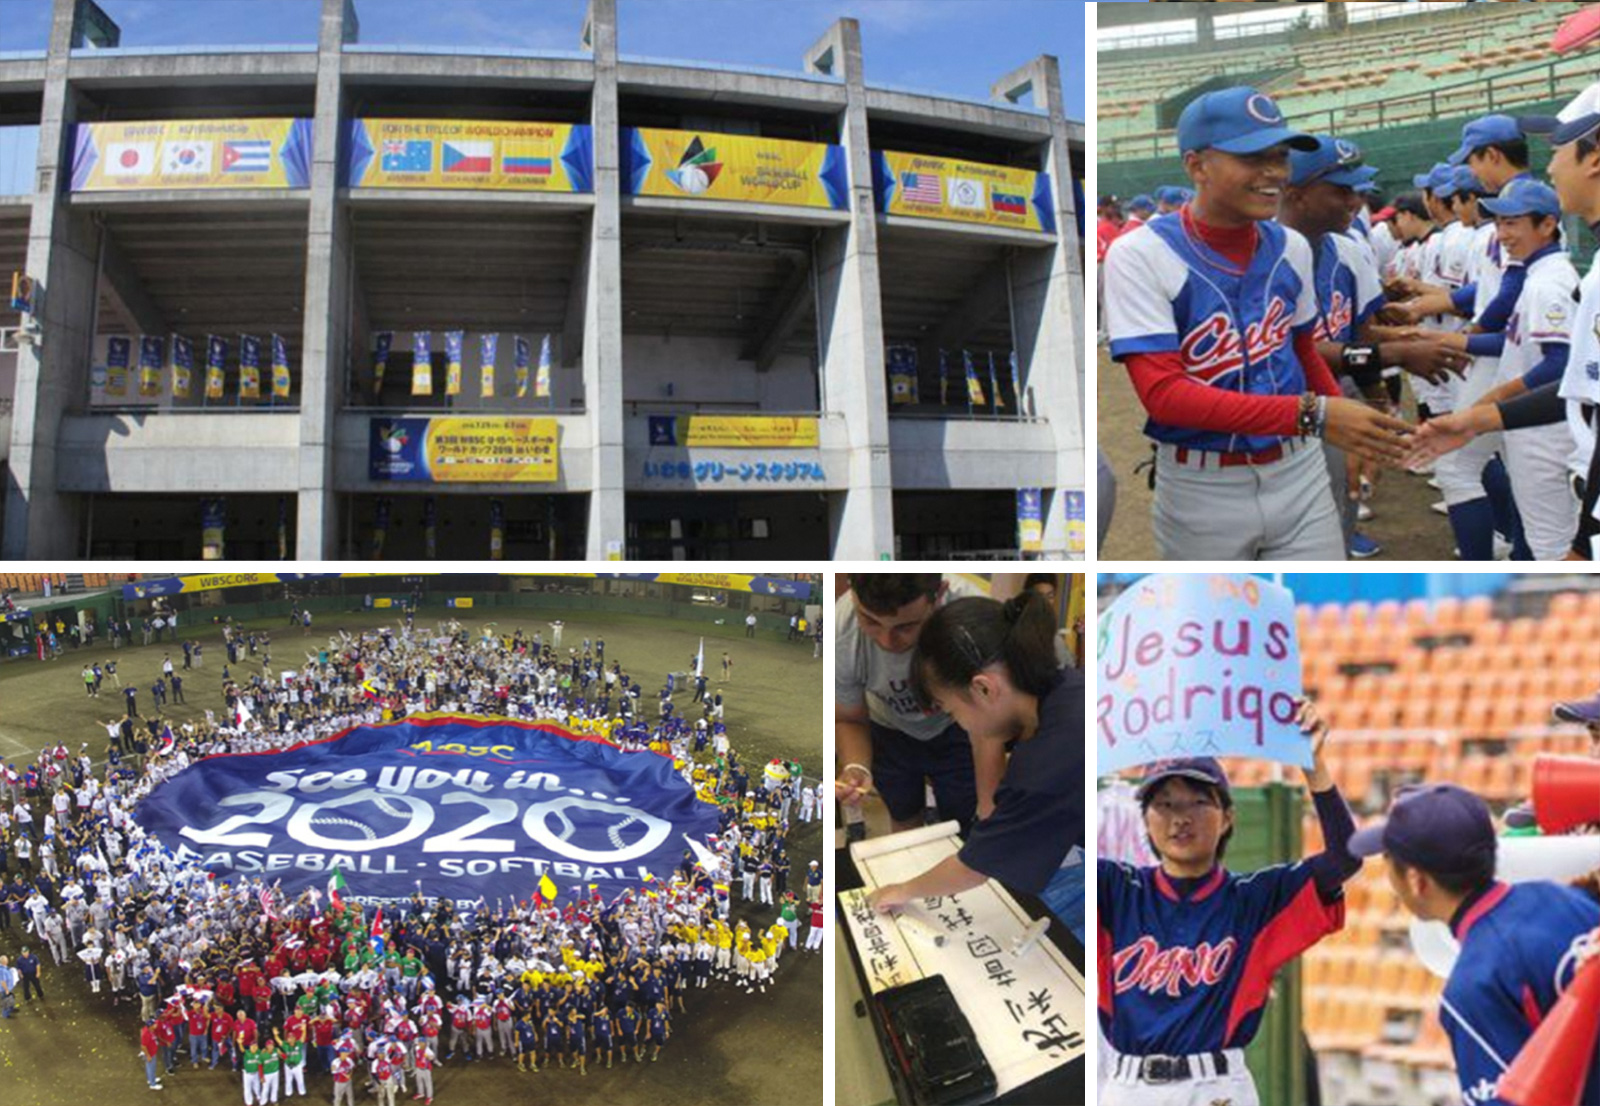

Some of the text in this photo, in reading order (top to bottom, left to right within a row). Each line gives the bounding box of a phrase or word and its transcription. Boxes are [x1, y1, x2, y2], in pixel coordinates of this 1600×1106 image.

[1247, 93, 1281, 124] C
[643, 460, 825, 481] いわきグリーンスタジアム
[200, 573, 259, 588] WBSC.ORG
[1106, 613, 1290, 681] Jesus
[261, 767, 368, 794] See
[376, 765, 494, 796] you
[178, 788, 672, 863] 2020
[177, 843, 654, 881] BASEBALL SOFTBALL
